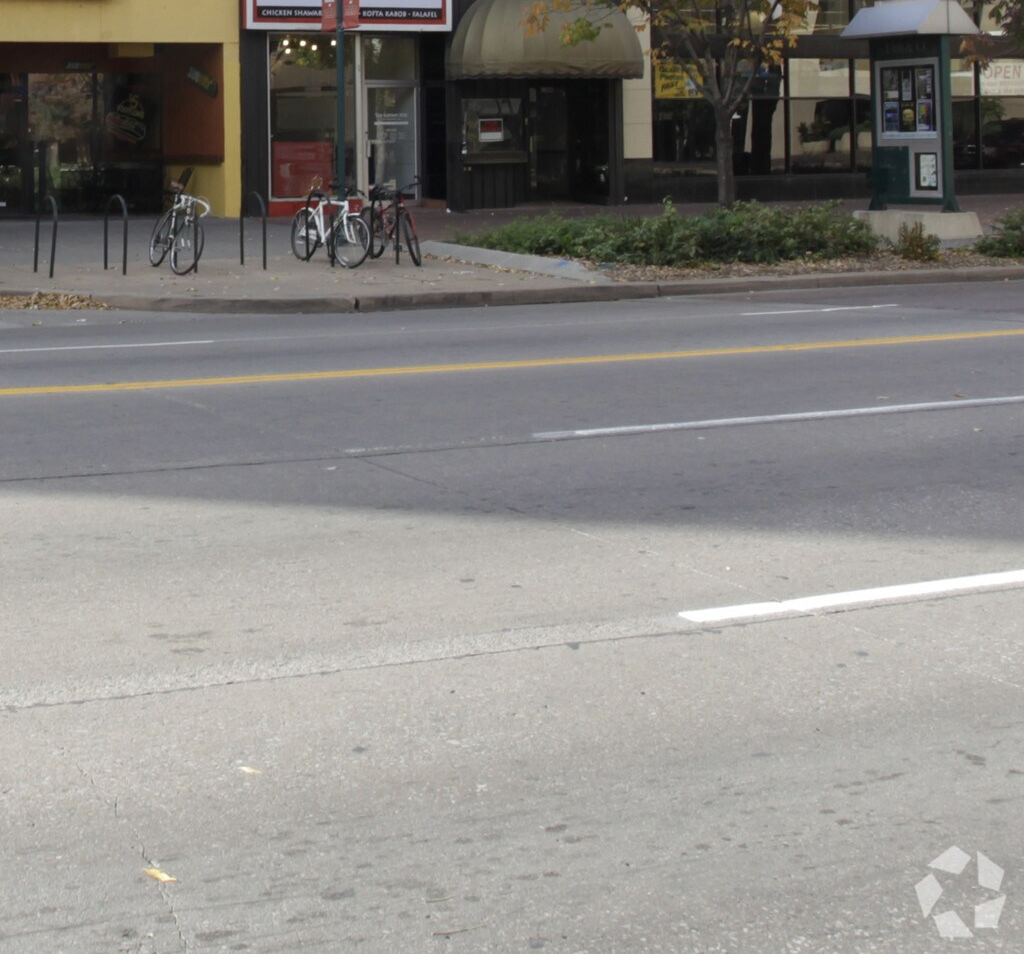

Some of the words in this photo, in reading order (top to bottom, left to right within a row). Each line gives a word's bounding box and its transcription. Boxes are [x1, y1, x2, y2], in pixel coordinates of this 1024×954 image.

[262, 9, 293, 17] CHICKEN
[385, 10, 407, 18] KABOB
[412, 11, 438, 19] FALAFEL
[983, 64, 1022, 80] OPEN
